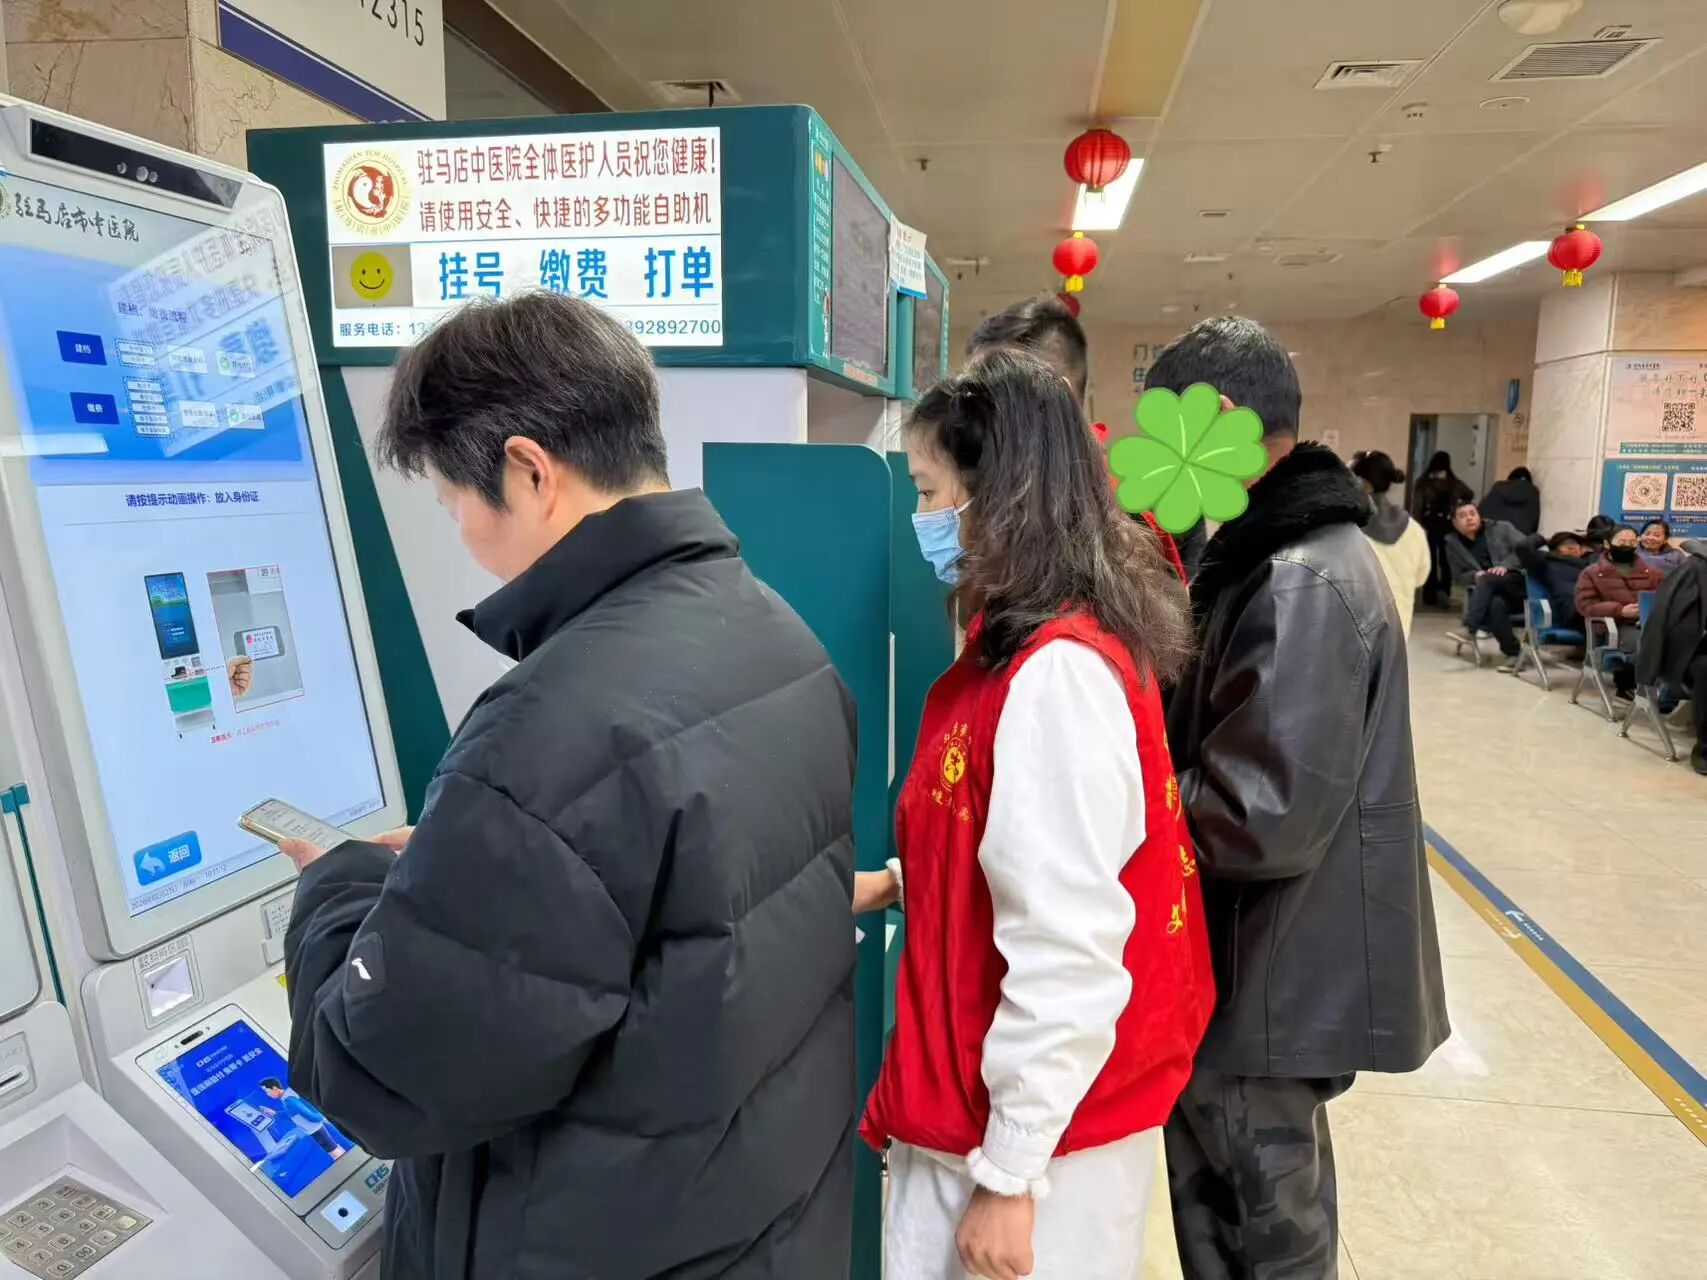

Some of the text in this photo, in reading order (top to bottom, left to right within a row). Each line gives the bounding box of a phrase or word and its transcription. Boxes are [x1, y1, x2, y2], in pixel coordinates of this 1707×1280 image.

[360, 0, 424, 46] 2315
[15, 192, 139, 242] 驻马店市中医院
[419, 191, 712, 233] 请使用安全、快捷的多功能自助机
[439, 246, 714, 300] 挂号 缴费 打单
[168, 844, 190, 864] 返回
